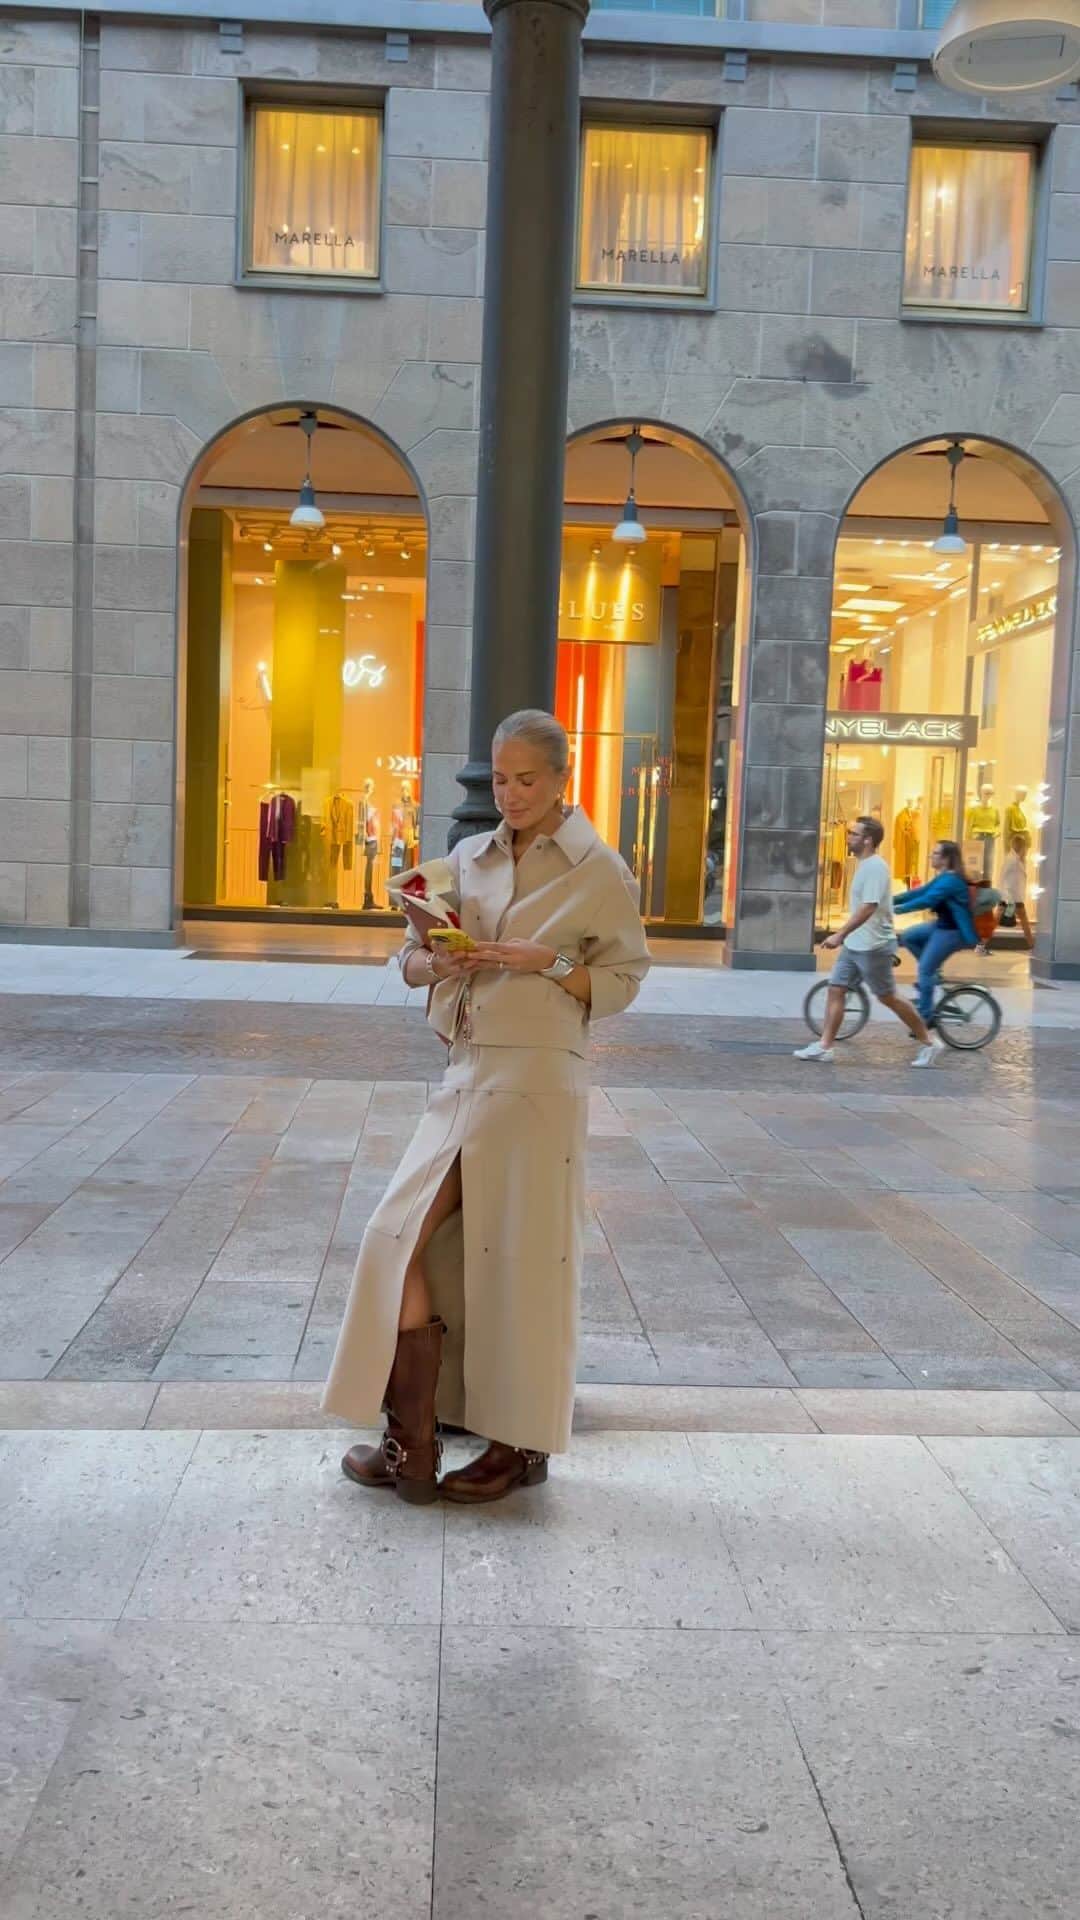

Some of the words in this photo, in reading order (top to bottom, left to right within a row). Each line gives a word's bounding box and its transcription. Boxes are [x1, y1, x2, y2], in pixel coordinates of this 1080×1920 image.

[274, 231, 355, 248] MARELLA
[601, 247, 681, 265] MARELLA
[923, 265, 1001, 281] MARELLA
[558, 600, 645, 621] LUES
